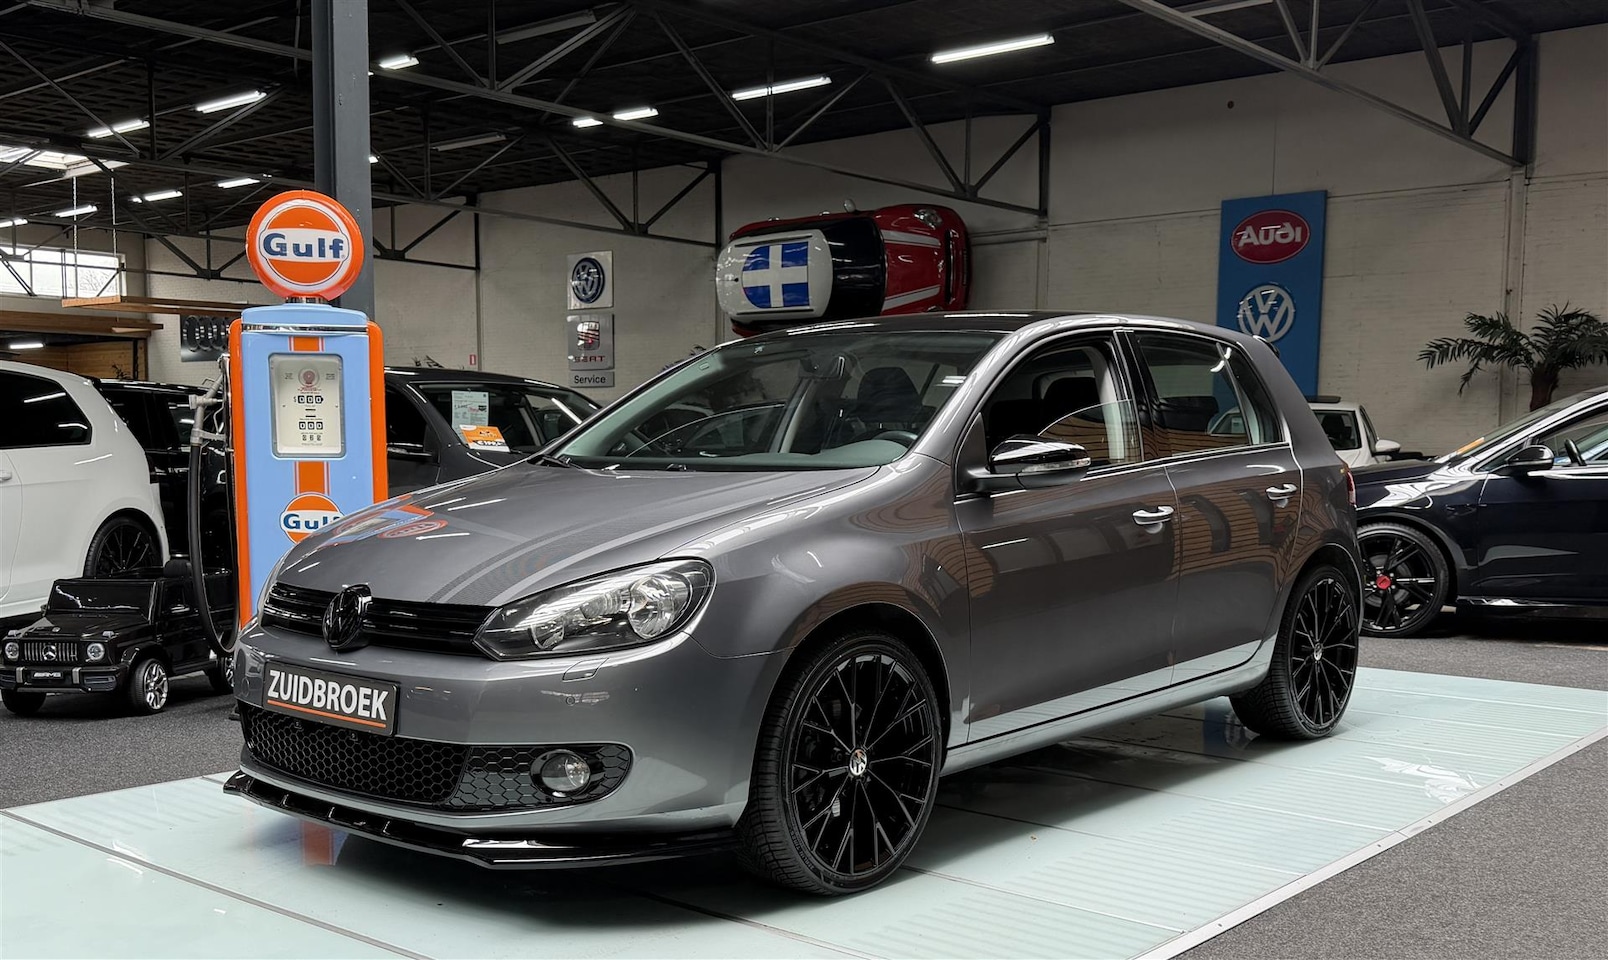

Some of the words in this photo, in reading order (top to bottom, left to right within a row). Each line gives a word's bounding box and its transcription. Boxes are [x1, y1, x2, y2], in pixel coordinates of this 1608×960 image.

[263, 233, 344, 259] Gulf
[574, 375, 606, 384] Service
[267, 669, 389, 721] ZUIDBROEK
